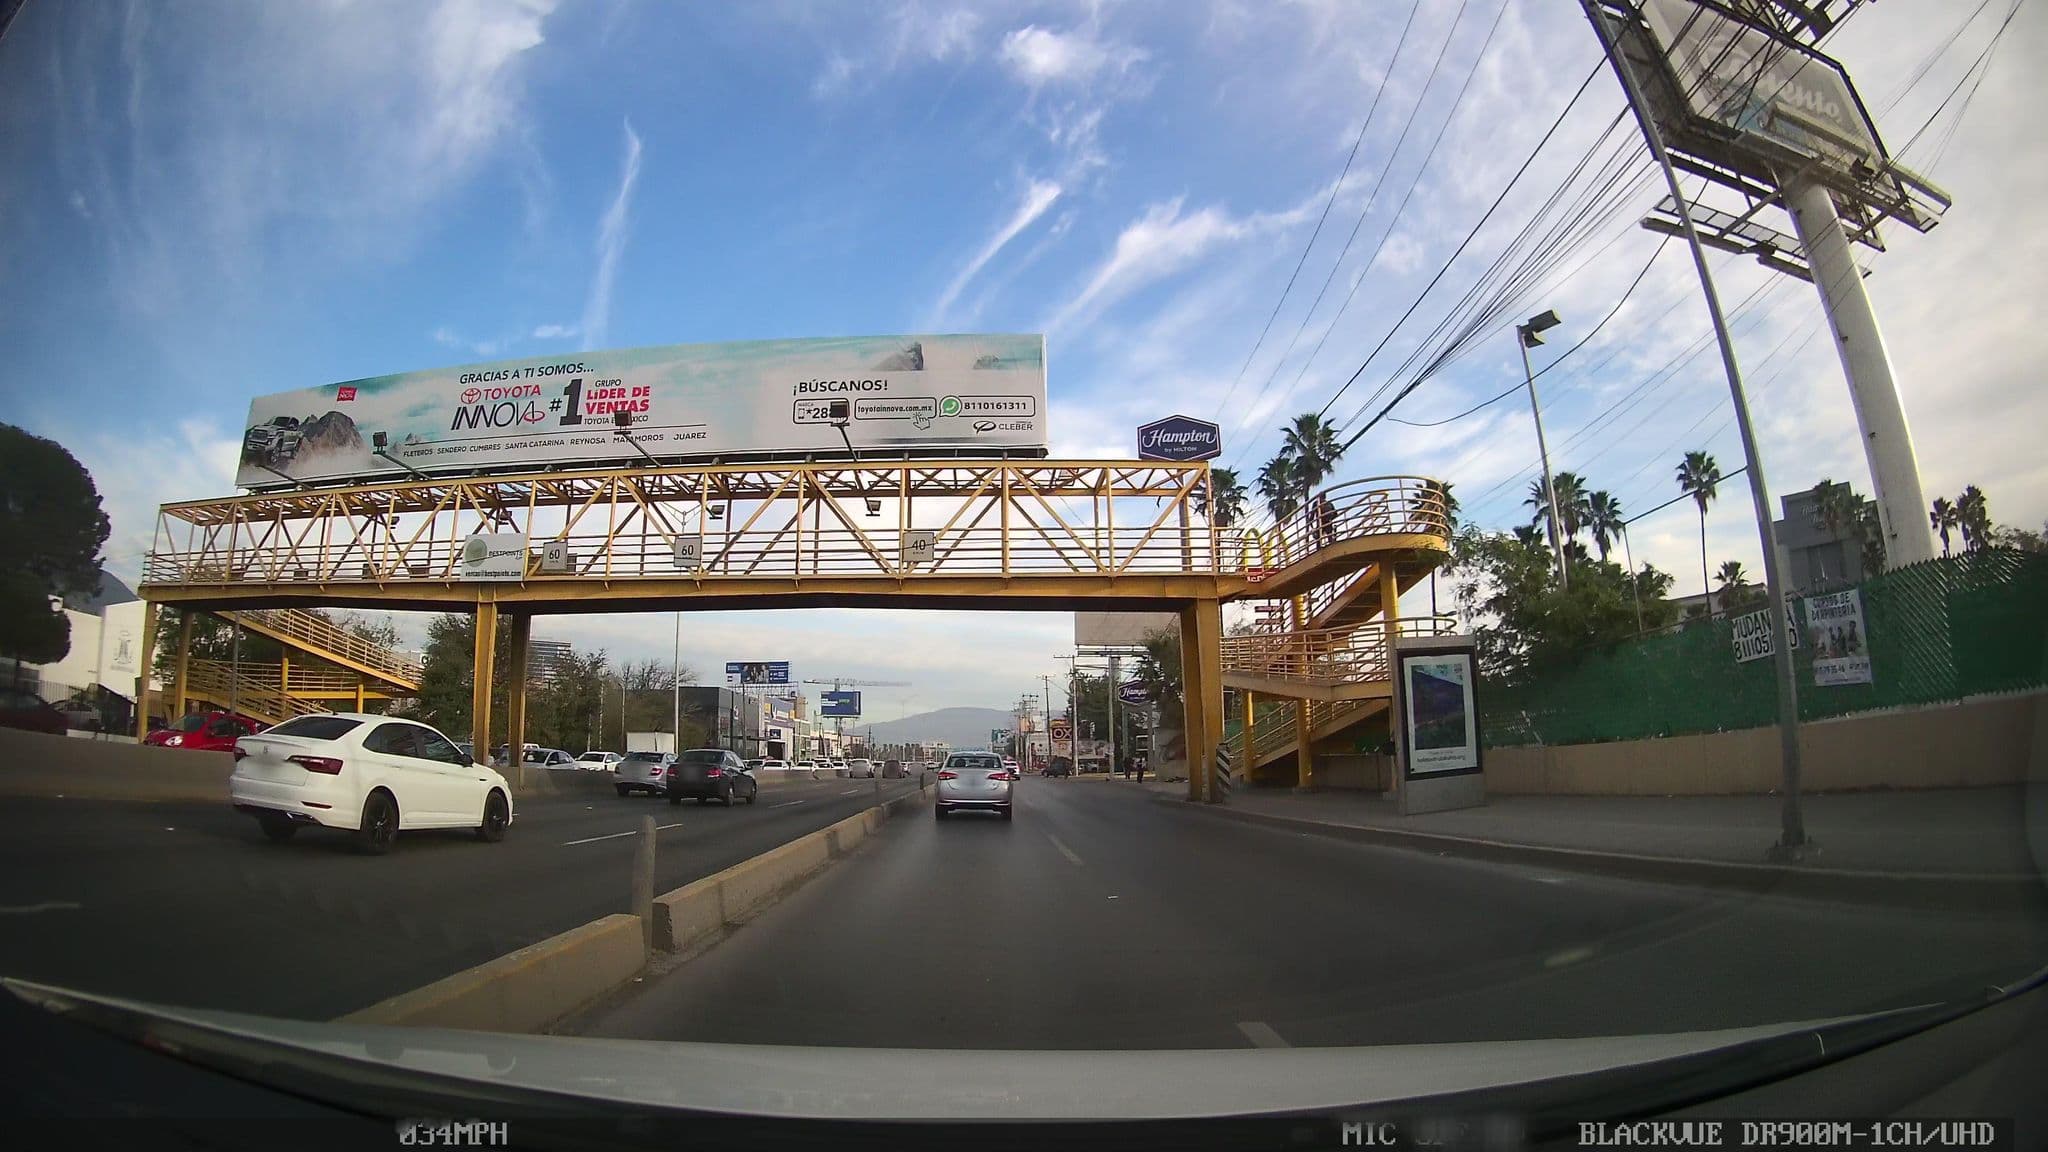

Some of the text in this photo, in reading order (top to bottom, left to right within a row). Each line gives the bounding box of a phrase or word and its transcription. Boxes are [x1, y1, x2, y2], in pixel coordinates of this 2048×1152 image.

[460, 363, 594, 384] GRACIAS A TI SOMOS...
[595, 379, 622, 387] GRUPO
[793, 379, 888, 396] ¡BÚSCANOS!
[483, 384, 541, 401] TOYOTA
[632, 386, 650, 398] DE
[585, 399, 650, 414] VENTAS
[857, 404, 933, 415] toyotainnova.com.mx
[964, 402, 1027, 410] 8110161311
[451, 401, 545, 430] INNOVA
[584, 417, 610, 425] TOYOTA
[998, 423, 1033, 431] CLEBER
[436, 445, 467, 455] SENDERO
[469, 443, 501, 452] CUMBRES
[504, 441, 528, 450] SANTA
[529, 439, 565, 448] CATARINA
[570, 437, 606, 445] REYNOSA
[673, 432, 707, 441] JUAREZ
[1142, 428, 1217, 448] Hampton
[681, 544, 694, 556] 60
[912, 539, 926, 551] 40
[549, 548, 560, 560] 60
